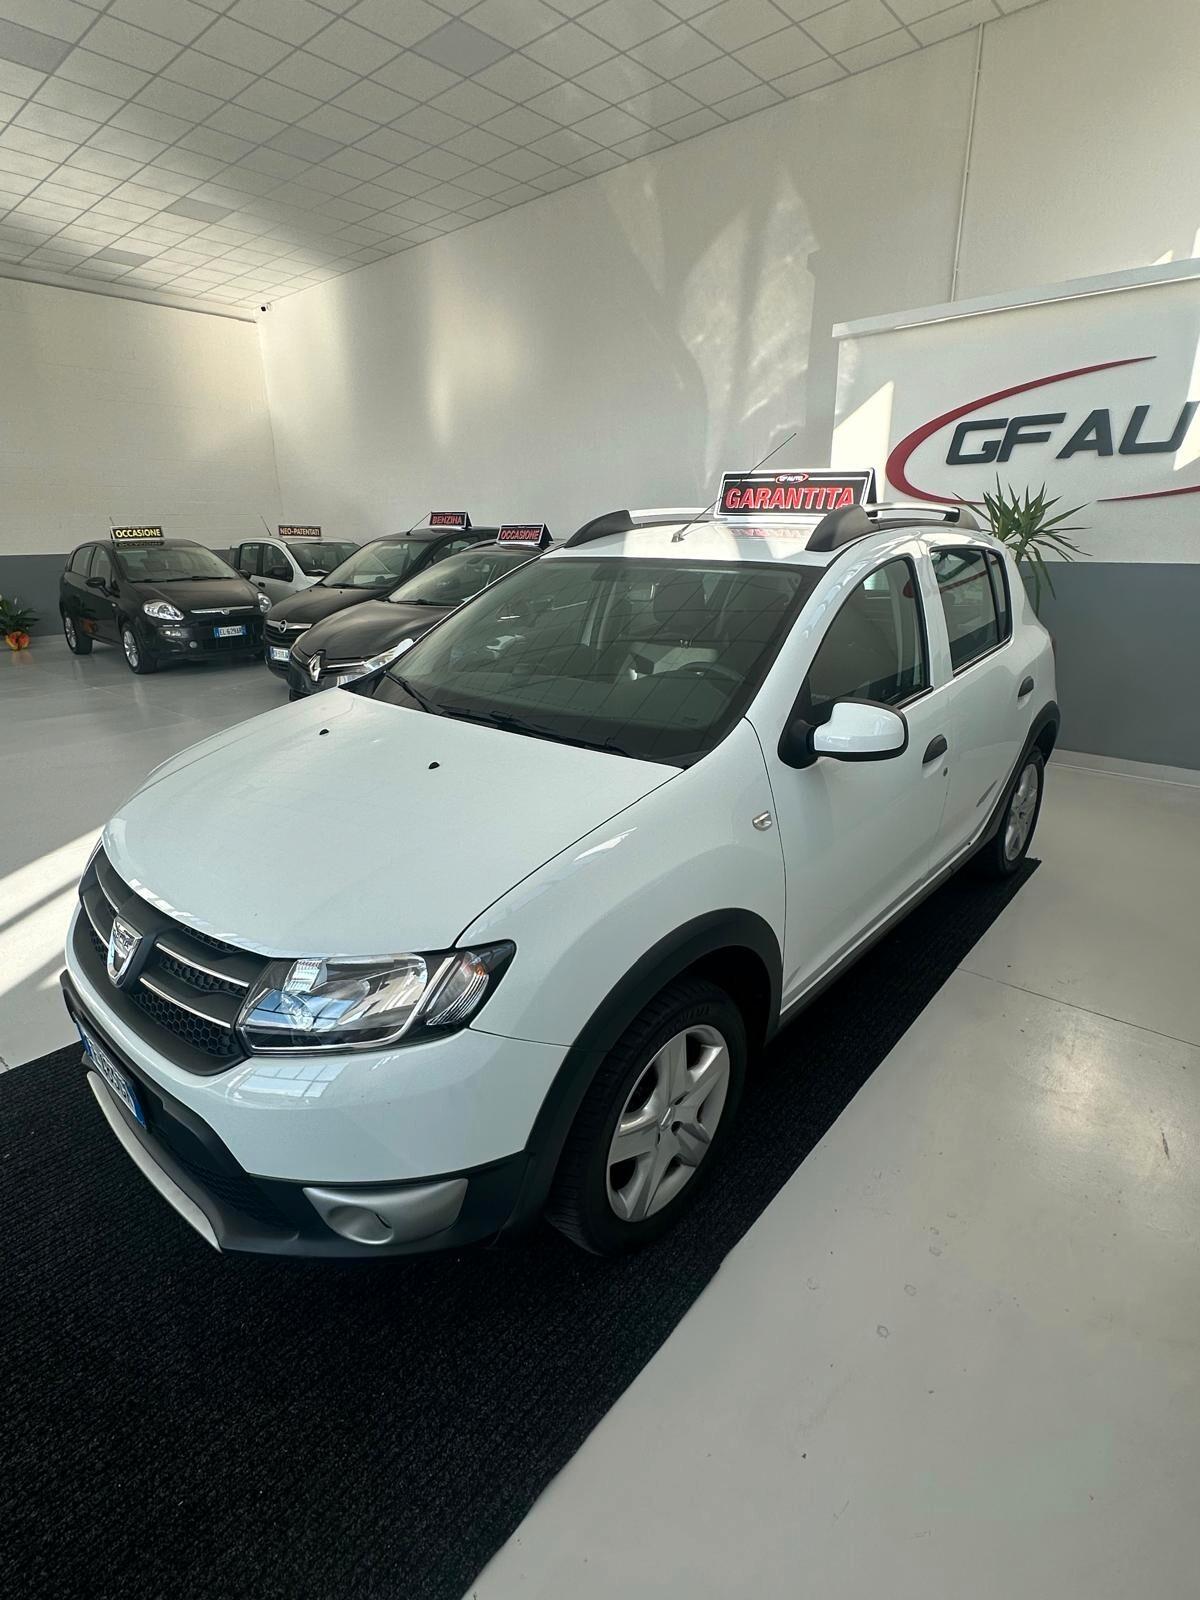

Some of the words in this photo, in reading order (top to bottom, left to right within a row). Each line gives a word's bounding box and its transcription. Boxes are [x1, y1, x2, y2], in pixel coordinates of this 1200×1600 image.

[725, 487, 855, 510] GARANTITA
[432, 515, 462, 525] BENZINA
[115, 529, 161, 538] OCCASIONE
[280, 527, 320, 536] NEO-PATENTATI
[501, 530, 540, 540] OCCASIONE
